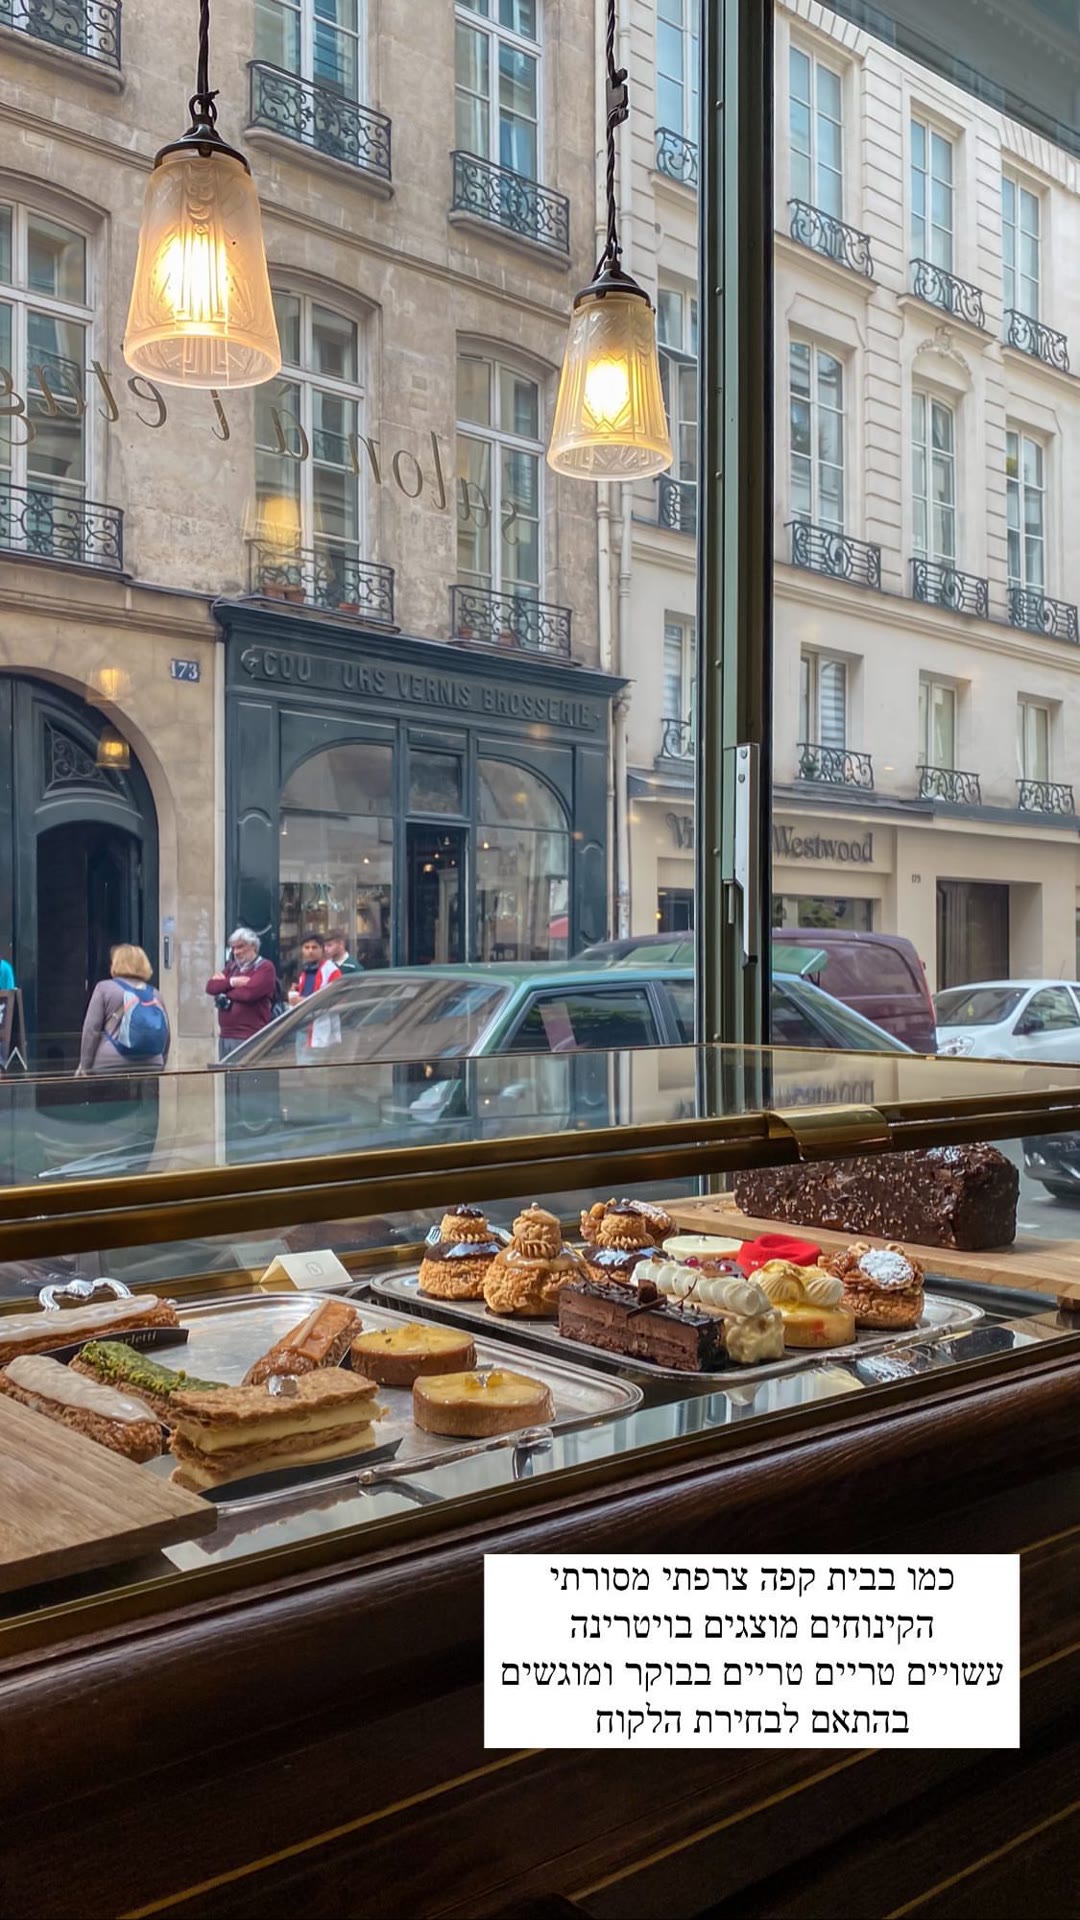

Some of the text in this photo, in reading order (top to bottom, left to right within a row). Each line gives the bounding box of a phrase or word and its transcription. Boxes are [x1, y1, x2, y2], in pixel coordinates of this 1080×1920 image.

[170, 660, 198, 680] 173
[396, 671, 471, 708] VERNIS
[481, 687, 590, 727] BROSSERIE
[772, 825, 875, 864] Westwood
